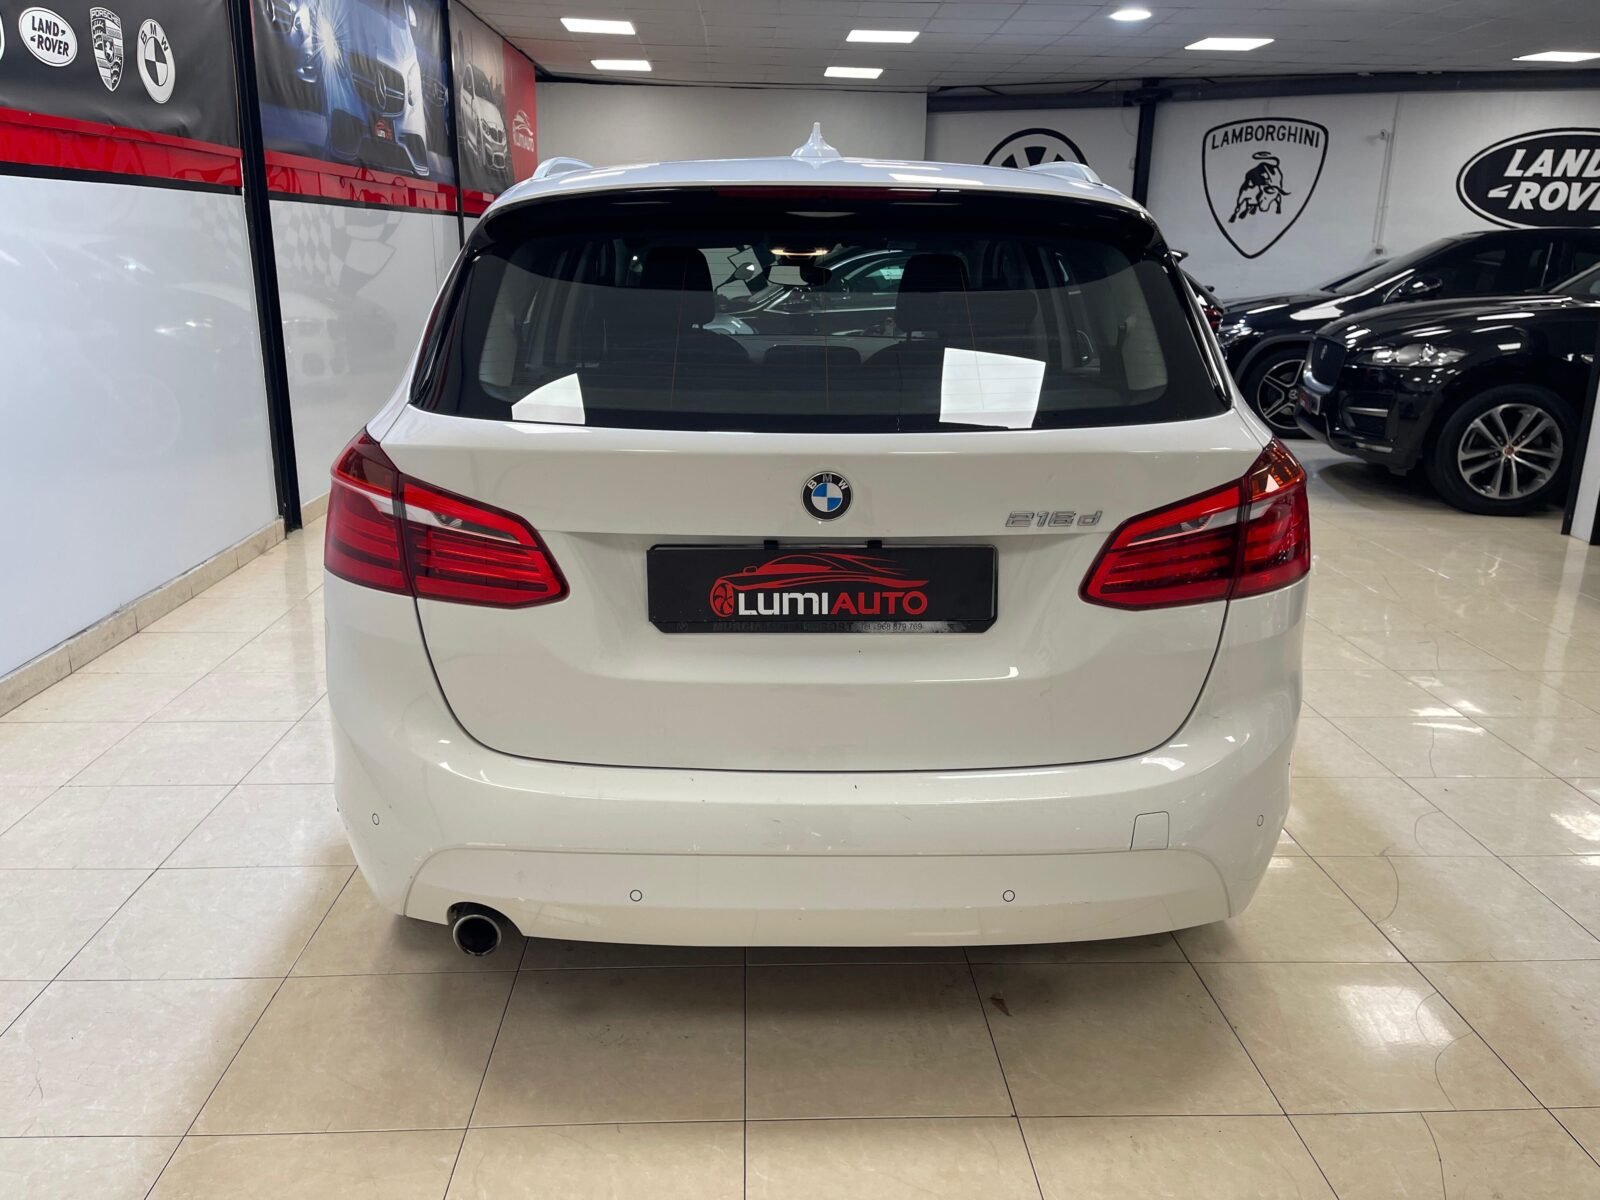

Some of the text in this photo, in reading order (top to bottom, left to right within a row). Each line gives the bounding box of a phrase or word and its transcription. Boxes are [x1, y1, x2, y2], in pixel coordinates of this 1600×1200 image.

[32, 15, 60, 36] LAND
[37, 37, 70, 57] ROVER
[140, 22, 169, 52] BMW
[1210, 123, 1321, 150] LAMBORGHINI
[807, 473, 849, 491] BMW
